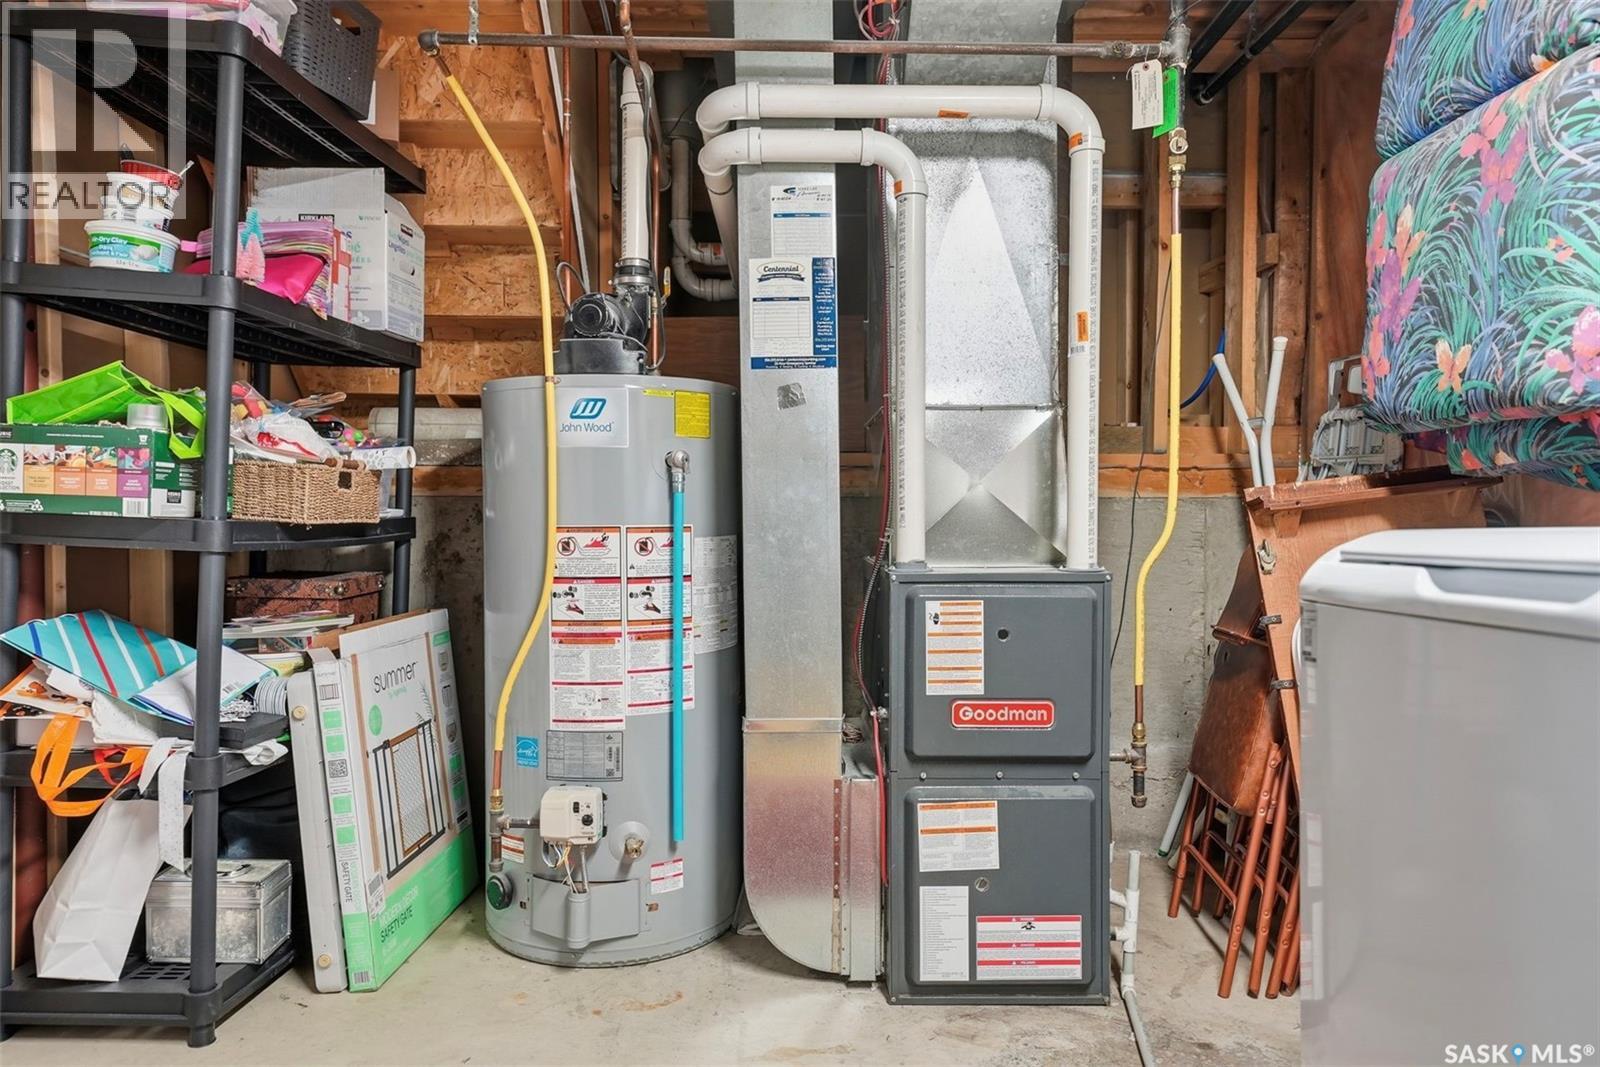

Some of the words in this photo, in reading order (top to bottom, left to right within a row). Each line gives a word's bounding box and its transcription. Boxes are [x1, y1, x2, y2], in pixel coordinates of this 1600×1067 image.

[763, 265, 799, 273] Centennial
[559, 422, 583, 433] John
[585, 422, 612, 433] Wood
[373, 661, 417, 693] summer
[959, 706, 1048, 721] Goodman
[341, 862, 351, 886] SAFETY
[344, 886, 353, 903] GATE
[380, 917, 400, 943] SAFETY
[401, 905, 414, 926] GATE
